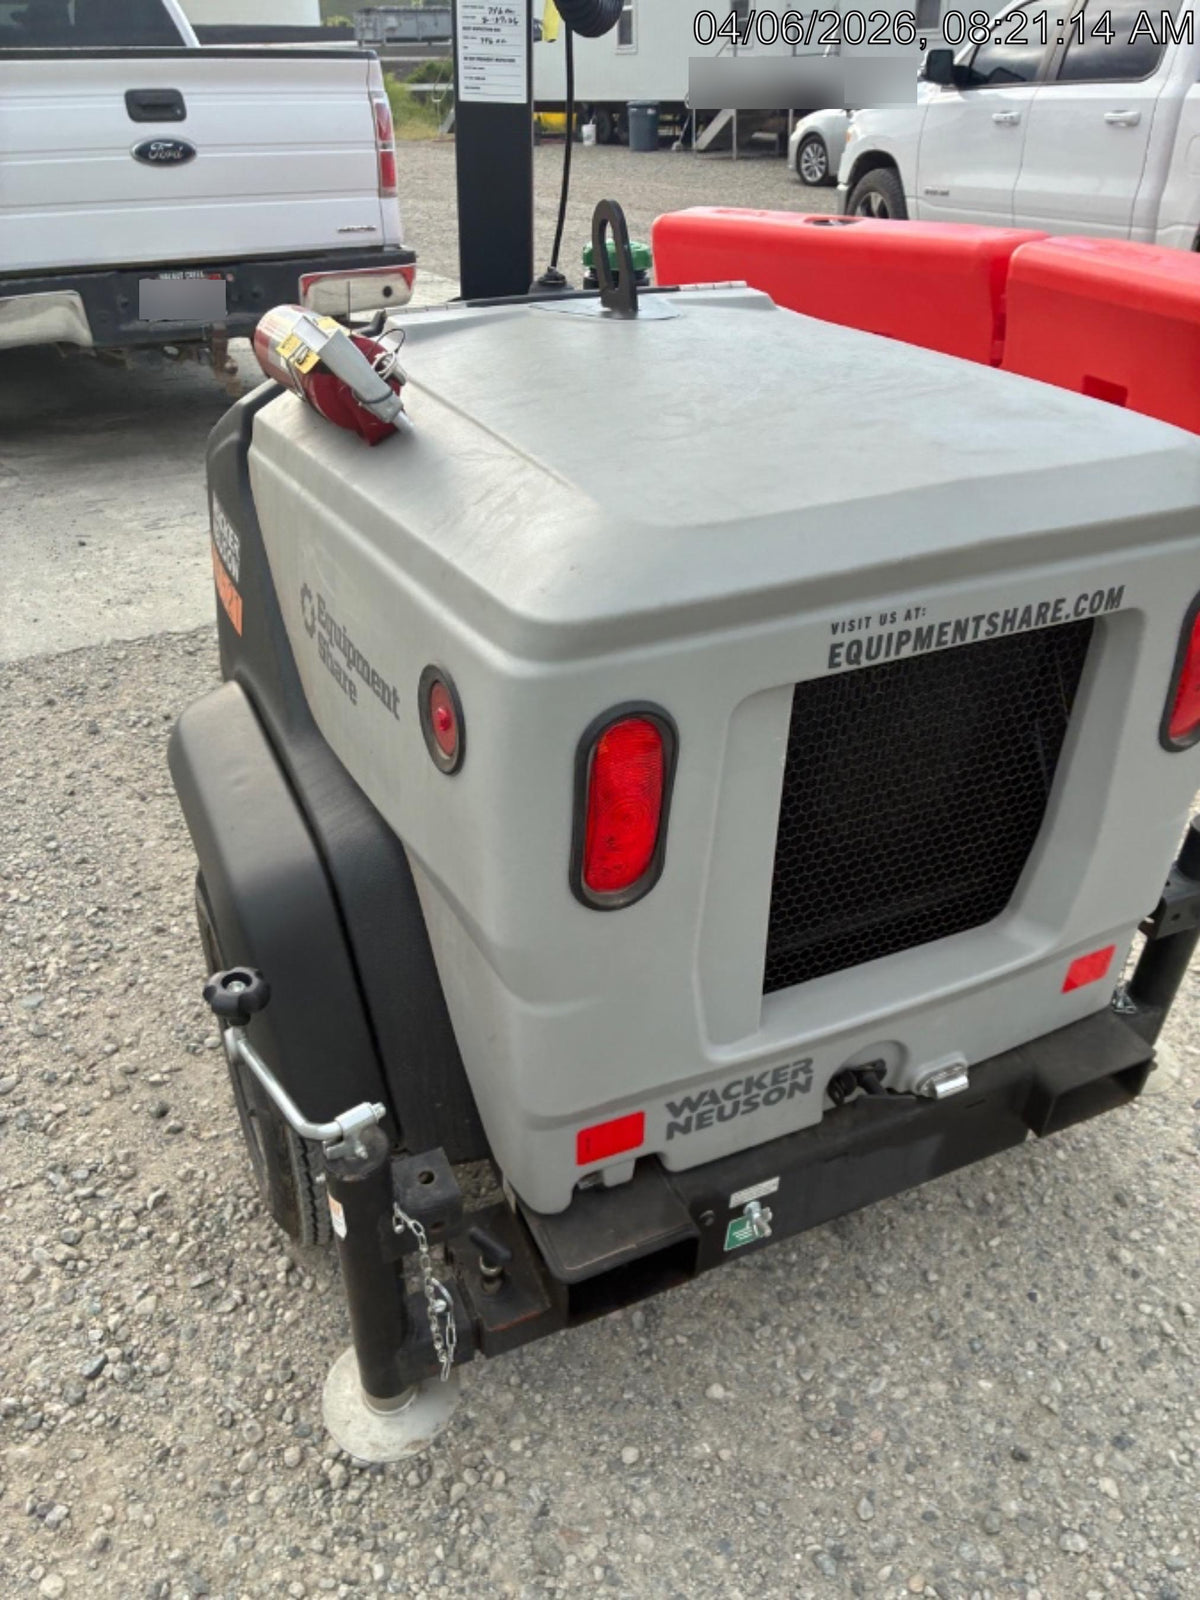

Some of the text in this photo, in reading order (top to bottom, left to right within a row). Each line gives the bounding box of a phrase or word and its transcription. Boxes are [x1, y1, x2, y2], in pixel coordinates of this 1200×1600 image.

[148, 141, 184, 160] Ford
[827, 584, 1126, 670] EQUIPMENTSHARE.COM
[831, 606, 927, 635] VISIT US AT:
[316, 592, 400, 719] Equipment
[318, 632, 358, 706] Share
[665, 1057, 814, 1118] WACKER
[666, 1075, 814, 1141] NEUSON
